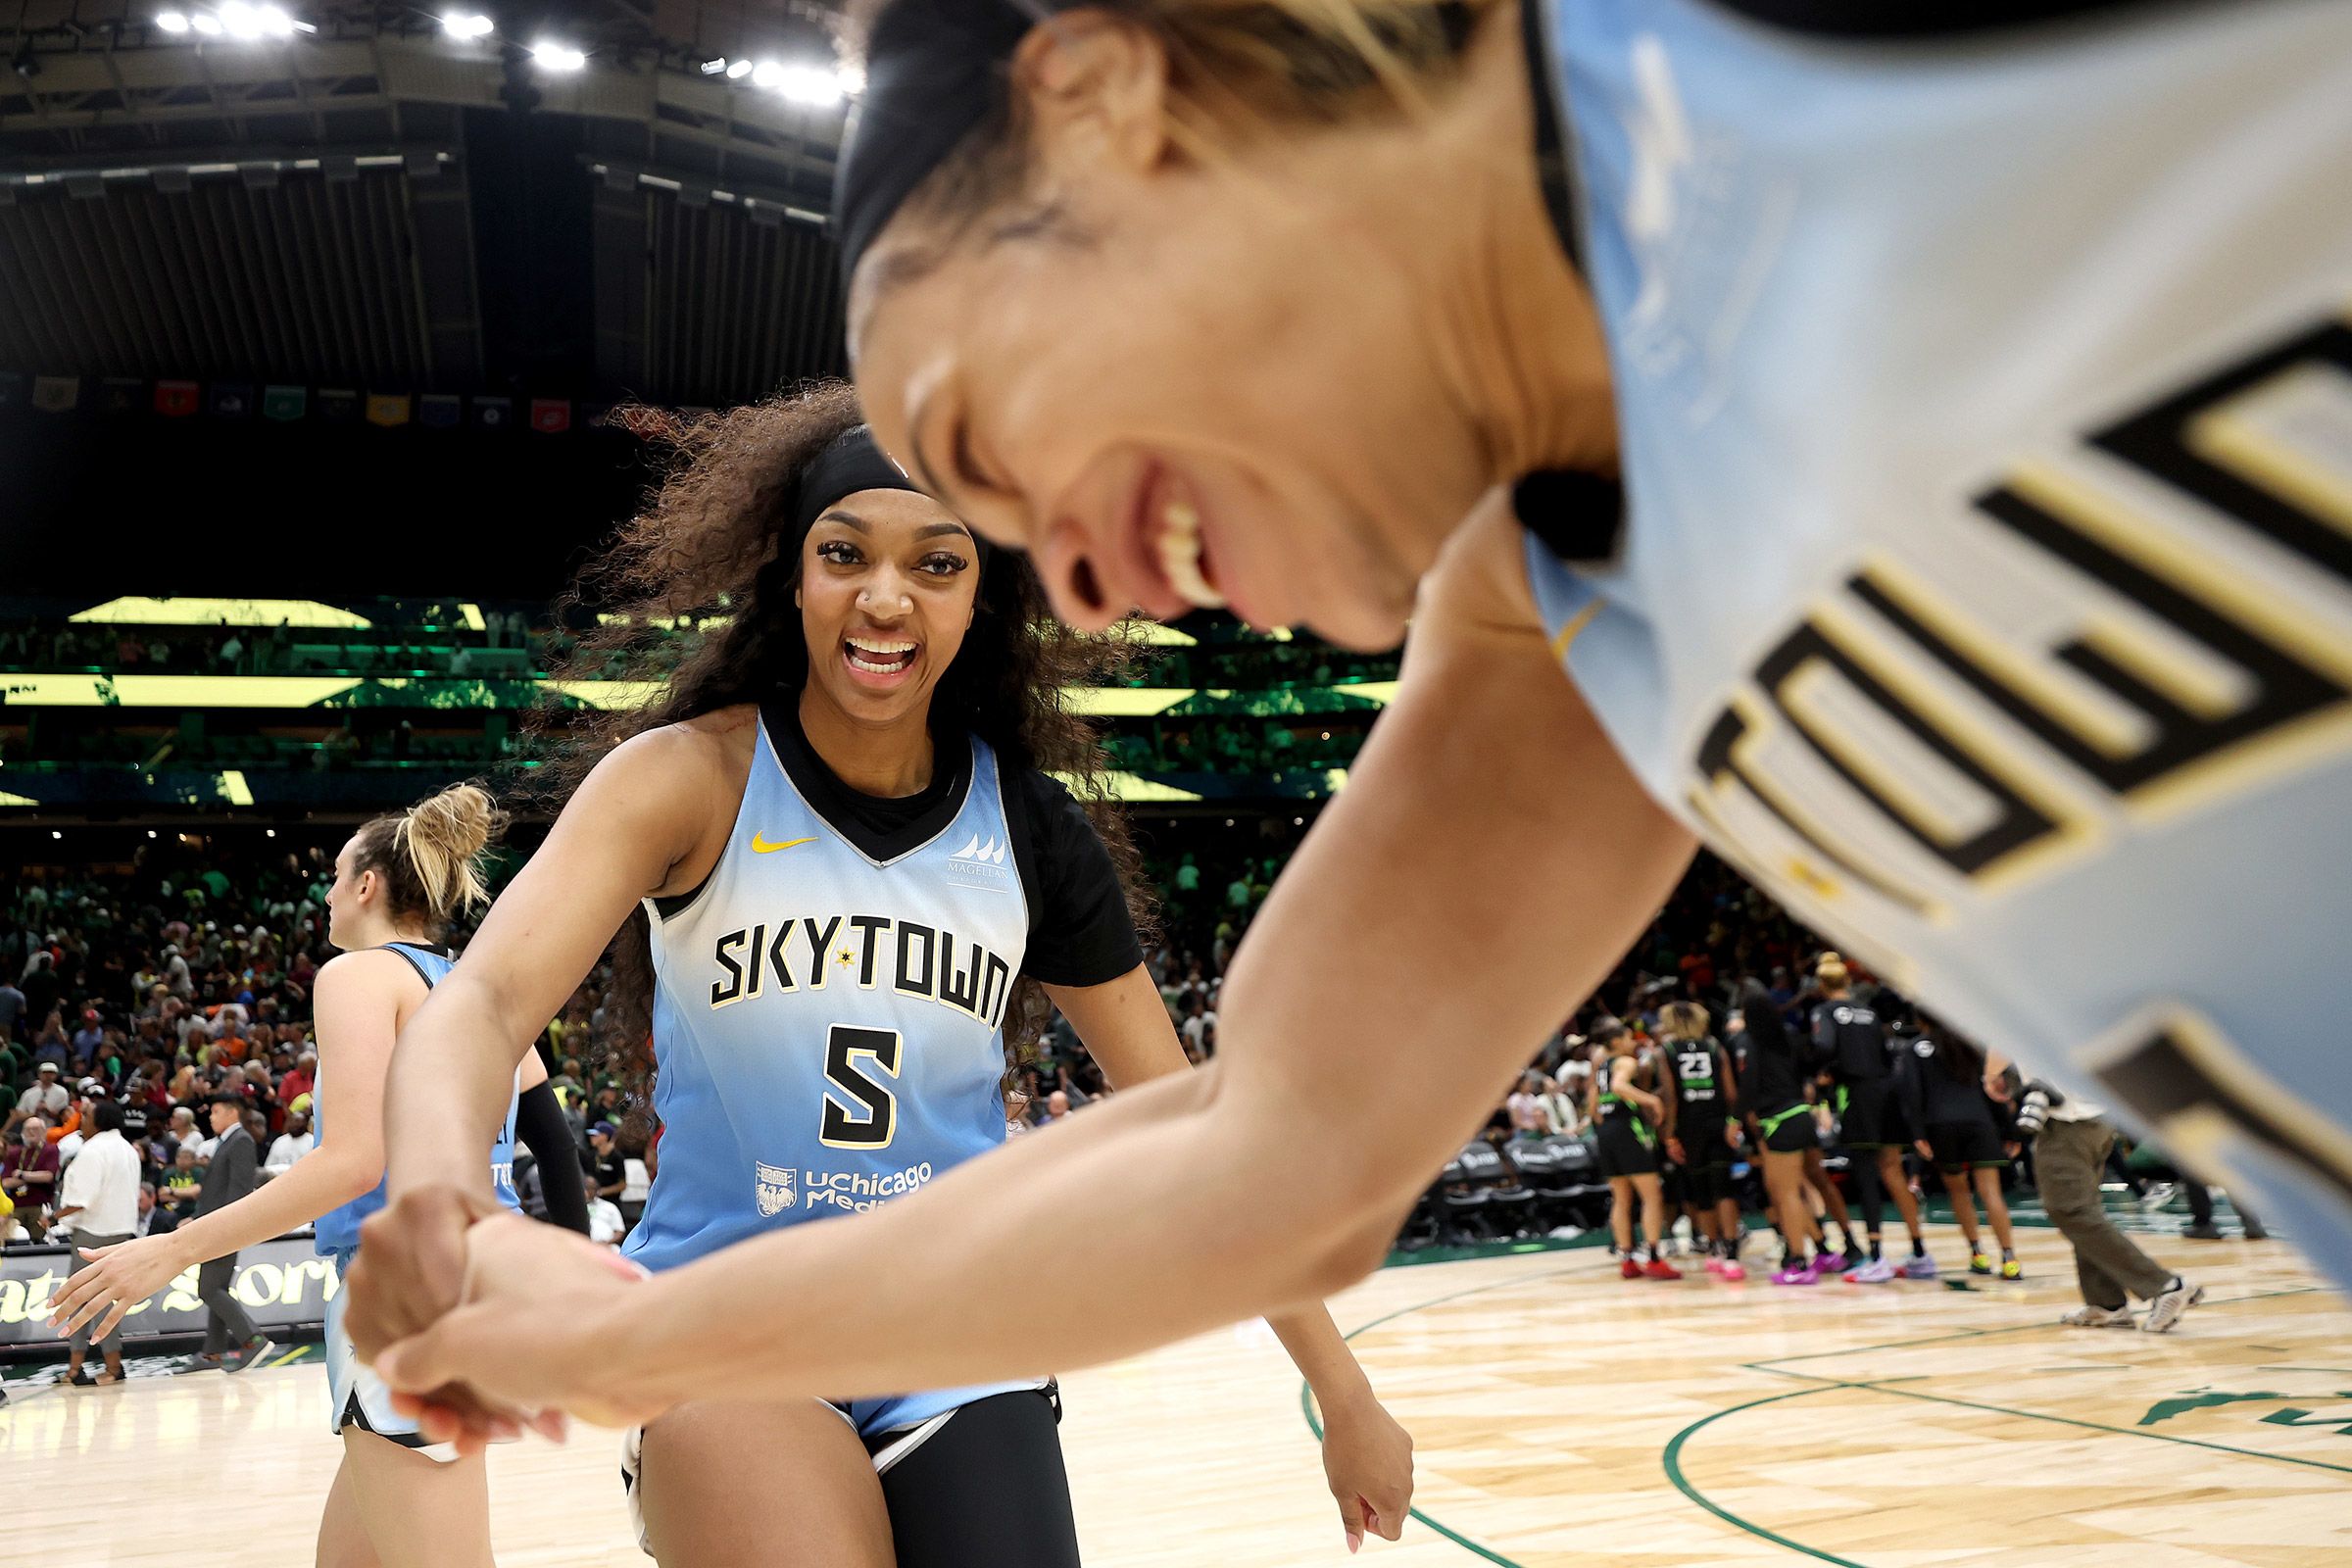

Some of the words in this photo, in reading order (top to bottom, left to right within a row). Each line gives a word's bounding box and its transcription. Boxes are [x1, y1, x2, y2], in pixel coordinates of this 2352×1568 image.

[948, 863, 1007, 879] MAGELLAN
[1678, 1052, 1713, 1080] 23
[819, 1023, 904, 1151] 5
[806, 1162, 932, 1195] UChicago
[807, 1189, 885, 1214] Med
